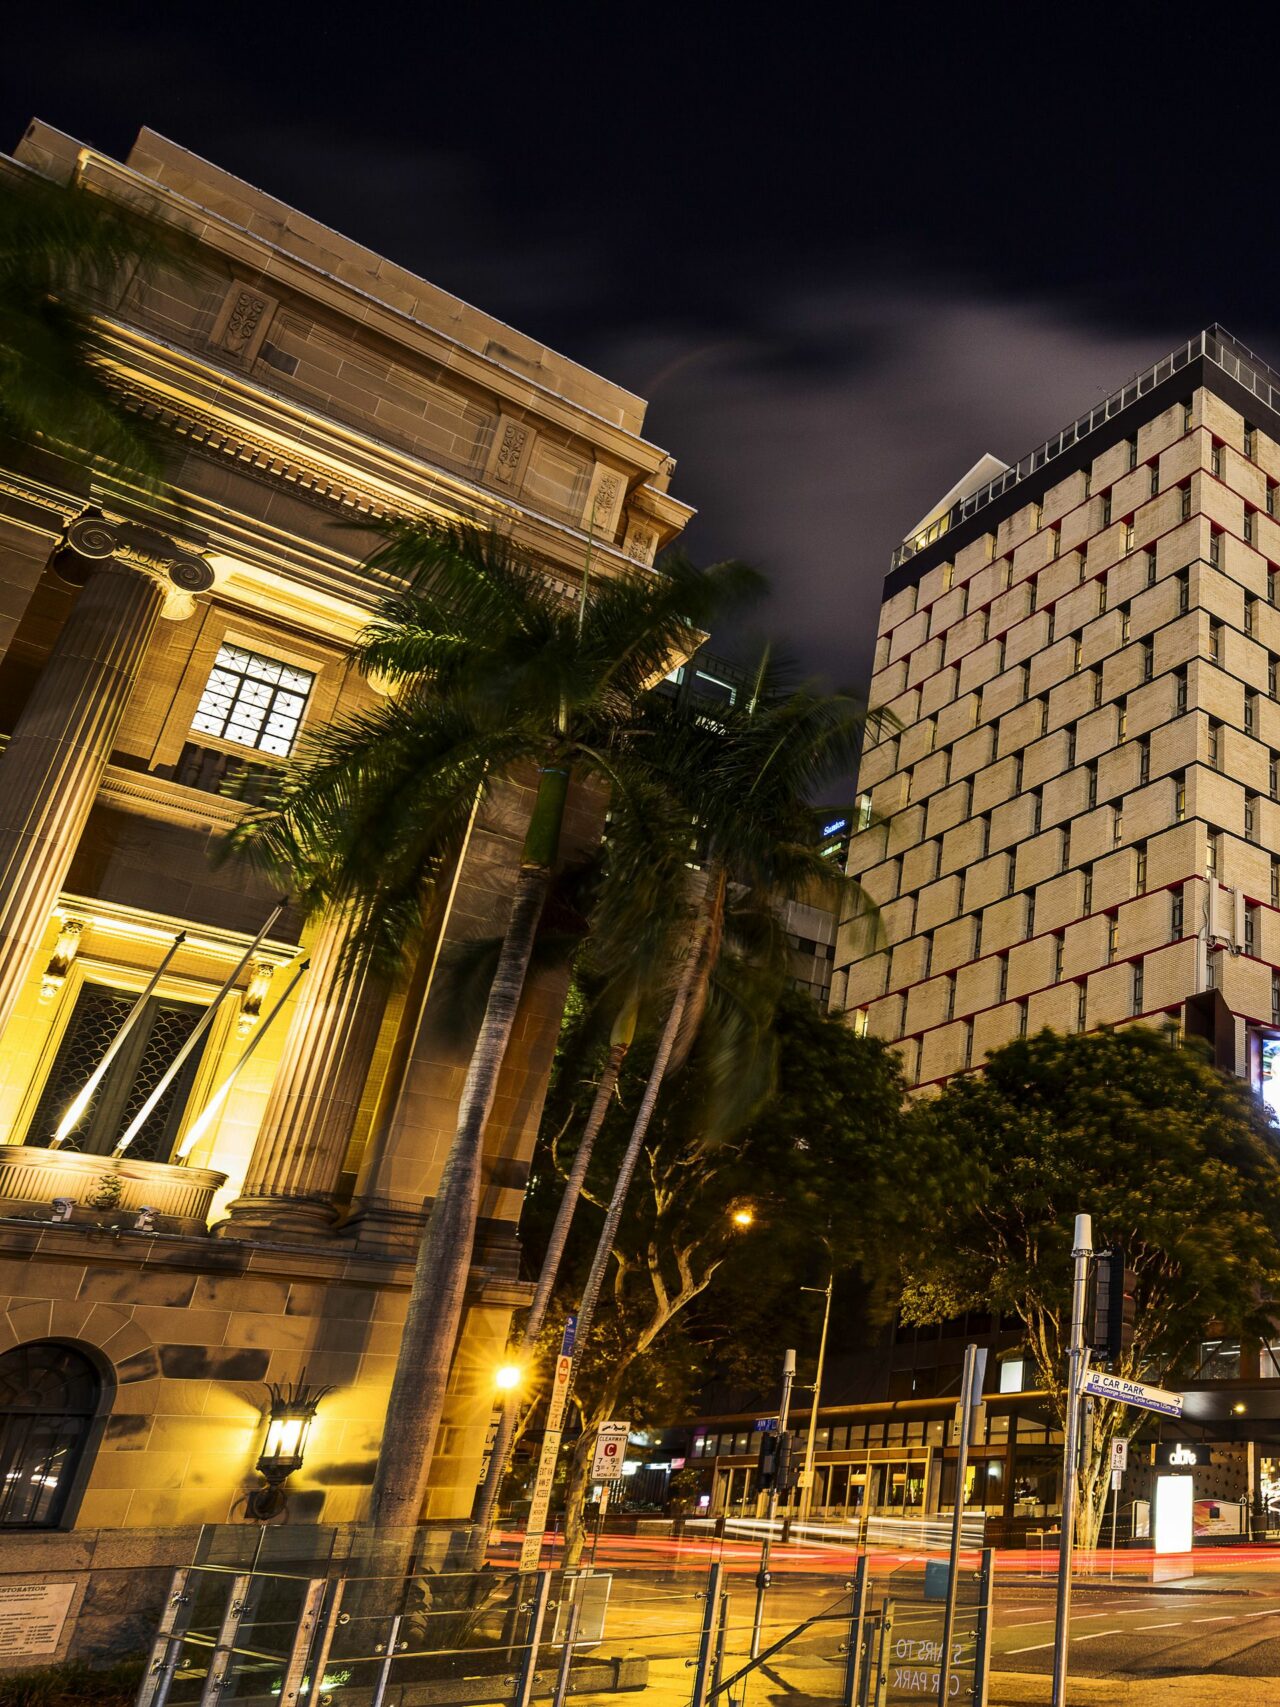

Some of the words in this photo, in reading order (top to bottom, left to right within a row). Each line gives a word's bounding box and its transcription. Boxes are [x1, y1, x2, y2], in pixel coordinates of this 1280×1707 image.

[824, 820, 845, 835] Santos
[1103, 1378, 1120, 1389] CAR
[1123, 1383, 1145, 1396] PARK
[1092, 1384, 1102, 1392] King
[1103, 1387, 1118, 1396] George
[1119, 1391, 1133, 1400] Square
[1134, 1395, 1145, 1403] Cycle
[1146, 1399, 1159, 1407] Centre
[605, 1443, 617, 1456] C
